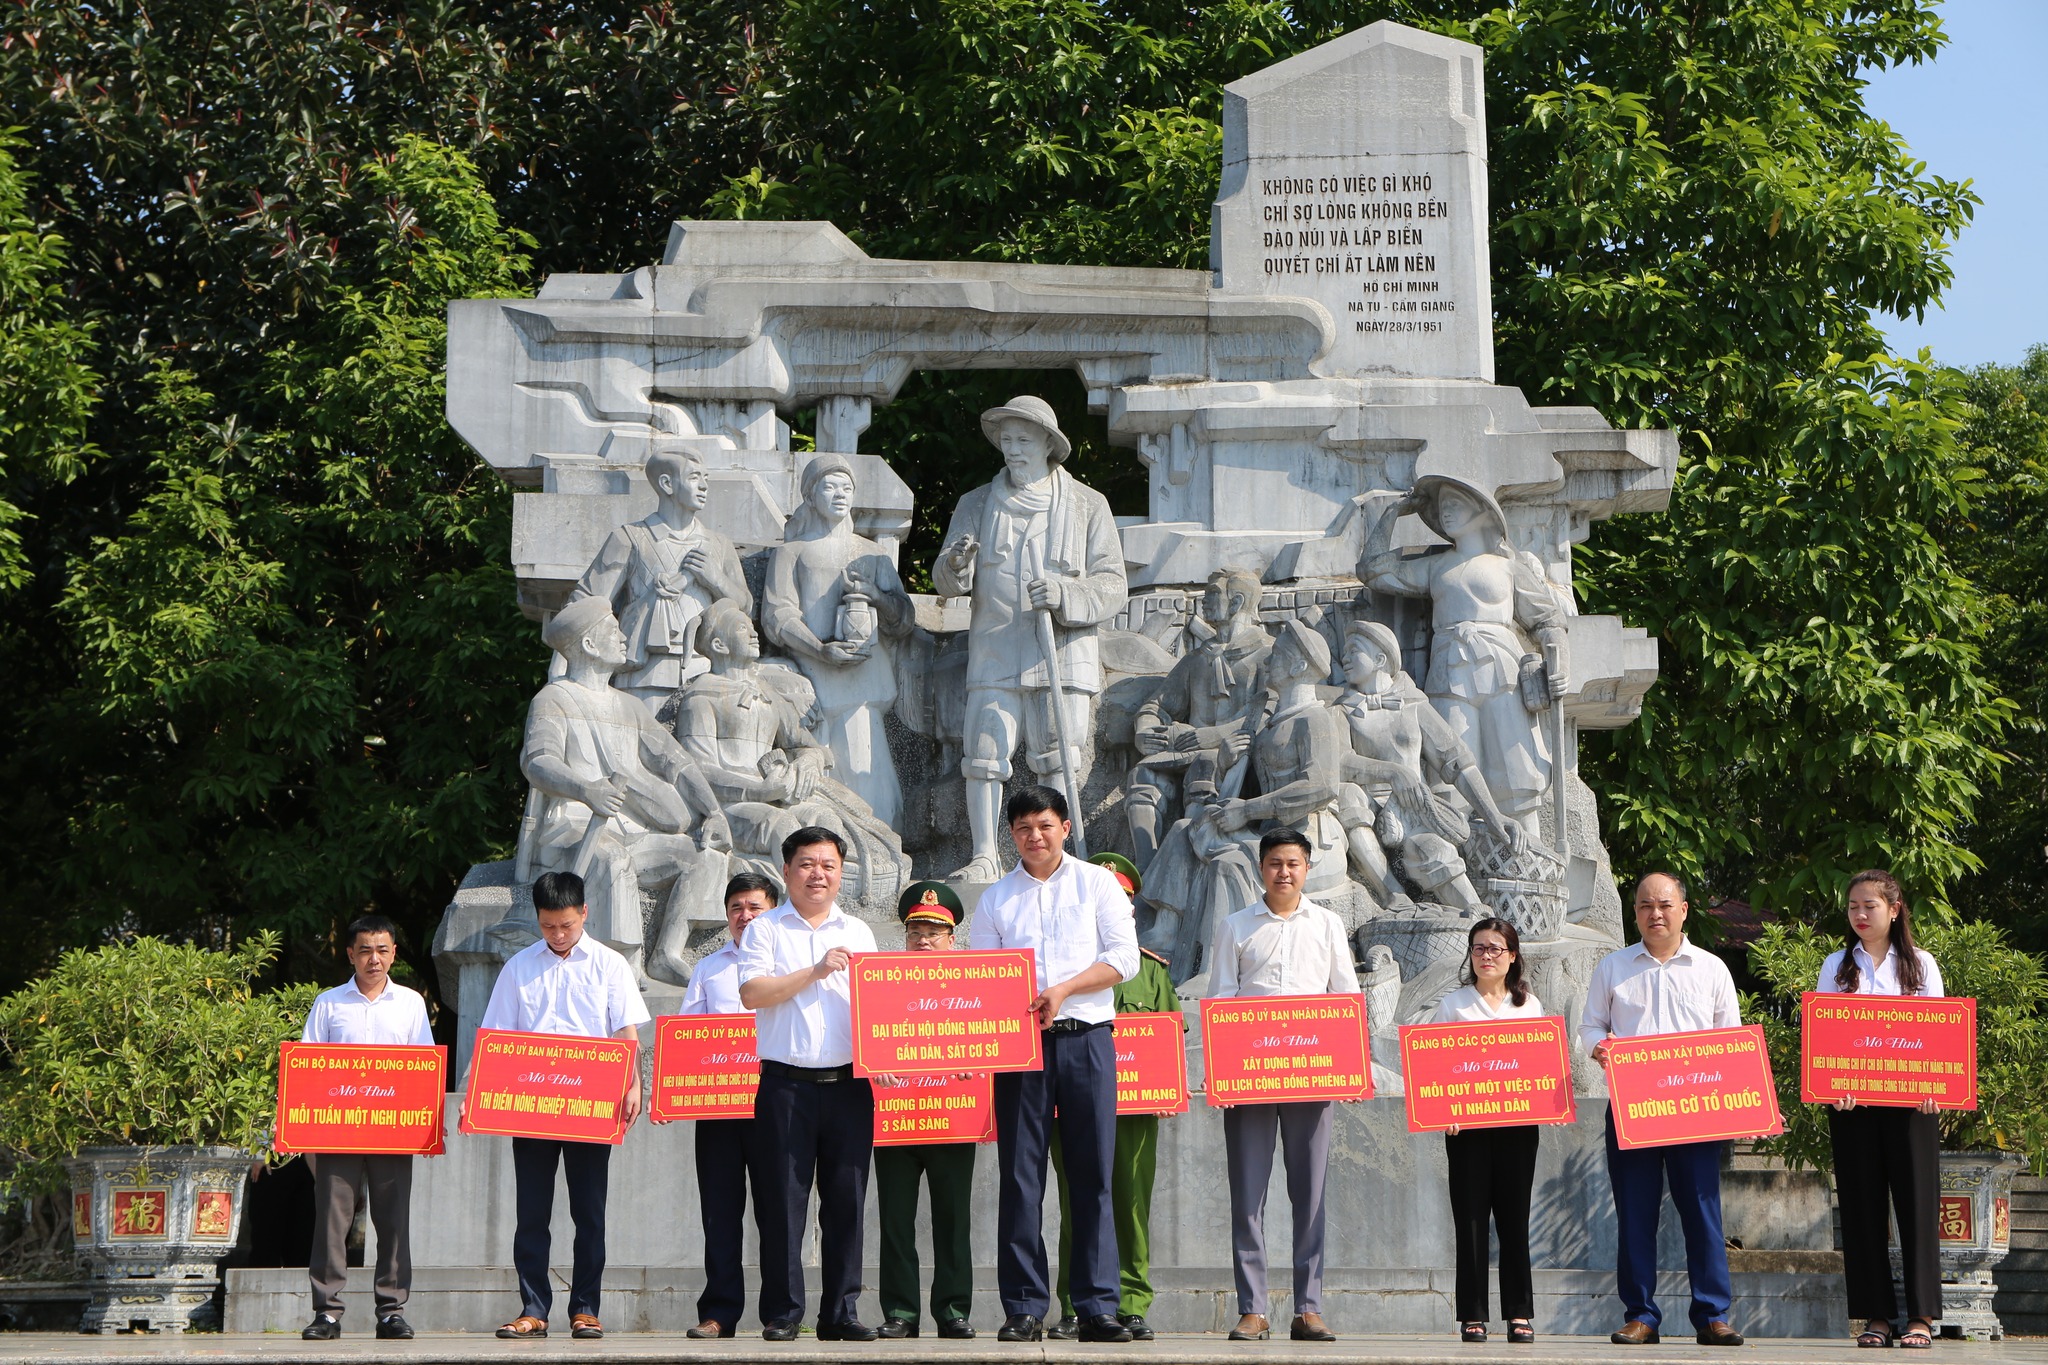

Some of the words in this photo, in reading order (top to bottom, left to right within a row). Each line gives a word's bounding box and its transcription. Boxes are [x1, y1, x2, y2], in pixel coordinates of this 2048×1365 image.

[1263, 176, 1313, 195] KHÔNG
[1344, 174, 1377, 196] VIỆC
[1383, 173, 1396, 192] GÌ
[1402, 172, 1432, 191] KHÓ
[1264, 200, 1288, 221] CHỈ
[1293, 203, 1313, 224] SỢ
[1318, 201, 1356, 219] LÒNG
[1362, 200, 1412, 219] KHÔNG
[1418, 196, 1447, 218] BỀN
[1263, 225, 1293, 247] ĐÀO
[1299, 223, 1324, 247] NÚI
[1330, 225, 1348, 246] VÀ
[1354, 224, 1381, 245] LẤP
[1388, 223, 1422, 245] BIỂN
[1264, 252, 1309, 275] QUYẾT
[1316, 254, 1340, 273] CHÍ
[1346, 252, 1362, 273] ẮT
[1368, 253, 1399, 272] LÀM
[1405, 253, 1435, 272] NÊN
[1384, 280, 1402, 292] CHÍ
[1408, 282, 1438, 291] MINH
[864, 970, 883, 981] CHI
[887, 966, 901, 984] BỘ
[906, 965, 925, 984] HỘI
[928, 962, 961, 980] ĐỒNG
[965, 964, 996, 979] NHÂN
[1000, 963, 1022, 978] DÂN
[907, 998, 938, 1011] Mô
[941, 996, 982, 1010] Hình
[1212, 1010, 1239, 1023] ĐẢNG
[1242, 1009, 1254, 1024] BỘ
[1257, 1008, 1268, 1021] UỶ
[1272, 1010, 1290, 1021] BAN
[1292, 1007, 1318, 1020] NHÂN
[1321, 1006, 1340, 1018] DÂN
[1342, 1006, 1355, 1018] XÃ
[1815, 1008, 1833, 1018] CHI
[1837, 1006, 1850, 1022] BỘ
[1853, 1008, 1874, 1020] VĂN
[1877, 1008, 1913, 1022] PHÒNG
[1916, 1009, 1946, 1023] ĐẢNG
[1949, 1010, 1962, 1024] UỶ
[675, 1030, 692, 1040] CHI
[696, 1026, 709, 1041] BỘ
[712, 1025, 724, 1038] UỶ
[728, 1028, 748, 1038] BAN
[872, 1024, 889, 1040] ĐẠI
[892, 1018, 914, 1037] BIỂU
[918, 1020, 934, 1039] HỘI
[938, 1017, 965, 1036] ĐỒNG
[968, 1019, 996, 1034] NHÂN
[1000, 1018, 1020, 1033] DÂN
[1122, 1028, 1136, 1037] AN
[1140, 1025, 1154, 1036] XÃ
[1253, 1036, 1280, 1048] Mô
[1283, 1035, 1319, 1046] Hình
[1412, 1036, 1439, 1050] ĐẢNG
[1442, 1035, 1454, 1050] BỘ
[1458, 1034, 1478, 1046] CÁC
[1481, 1035, 1495, 1044] CƠ
[1498, 1033, 1524, 1044] QUAN
[1527, 1029, 1554, 1042] ĐẢNG
[1853, 1036, 1882, 1048] Mô
[1885, 1037, 1923, 1049] Hình
[487, 1043, 500, 1053] CHI
[503, 1042, 514, 1057] BỘ
[517, 1042, 527, 1055] UỶ
[528, 1046, 545, 1056] BAN
[546, 1046, 562, 1061] MẶT
[565, 1048, 584, 1062] TRẬN
[587, 1046, 597, 1059] TỔ
[598, 1048, 622, 1062] QUỐC
[701, 1054, 727, 1064] Mô
[896, 1042, 917, 1061] GẦN
[921, 1044, 945, 1060] DÂN,
[947, 1042, 966, 1058] SÁT
[969, 1043, 982, 1058] CƠ
[985, 1039, 999, 1057] SỞ
[1614, 1053, 1631, 1064] CHI
[1635, 1049, 1648, 1065] BỘ
[1651, 1049, 1671, 1060] BAN
[1673, 1045, 1693, 1058] XÂY
[1696, 1044, 1724, 1059] DỰNG
[1727, 1039, 1755, 1053] ĐẢNG
[290, 1058, 308, 1068] CHI
[312, 1056, 326, 1072] BỘ
[329, 1059, 349, 1069] BAN
[352, 1057, 372, 1070] XÂY
[375, 1058, 404, 1073] DỰNG
[407, 1057, 436, 1071] ĐẢNG
[1243, 1056, 1260, 1070] XÂY
[1264, 1056, 1290, 1072] DỰNG
[1292, 1054, 1307, 1068] MÔ
[1310, 1053, 1332, 1067] HÌNH
[1453, 1061, 1480, 1073] Mô
[1483, 1059, 1519, 1070] Hình
[518, 1072, 545, 1083] Mô
[548, 1073, 582, 1086] Hình
[912, 1076, 948, 1088] Hình
[1216, 1080, 1229, 1091] DU
[1232, 1078, 1252, 1093] LỊCH
[1255, 1076, 1280, 1092] CỘNG
[1284, 1073, 1309, 1088] ĐỒNG
[1312, 1074, 1346, 1087] PHIÊNG
[1349, 1075, 1362, 1086] AN
[1420, 1082, 1443, 1098] MỖI
[1447, 1081, 1471, 1097] QUÝ
[1475, 1080, 1500, 1096] MỘT
[1504, 1078, 1532, 1094] VIỆC
[1535, 1074, 1556, 1089] TỐT
[1657, 1076, 1684, 1087] Mô
[1686, 1071, 1723, 1084] Hình
[1868, 1079, 1883, 1091] TRONG
[328, 1085, 356, 1096] Mô
[359, 1086, 396, 1096] Hình
[1142, 1088, 1176, 1102] MẠNG
[480, 1090, 492, 1109] THÍ
[493, 1087, 513, 1111] ĐIỂM
[514, 1092, 536, 1113] NÔNG
[537, 1094, 565, 1118] NGHIỆP
[566, 1096, 592, 1117] THÔNG
[593, 1101, 614, 1119] MINH
[880, 1098, 915, 1113] LƯỢNG
[919, 1096, 942, 1110] DÂN
[946, 1094, 976, 1110] QUÂN
[1451, 1102, 1462, 1116] VÌ
[1467, 1100, 1501, 1115] NHÂN
[1504, 1098, 1530, 1112] DÂN
[1628, 1098, 1677, 1119] ĐƯỜNG
[1680, 1094, 1699, 1113] CỜ
[1702, 1089, 1720, 1111] TỔ
[1724, 1086, 1762, 1110] QUỐC
[289, 1103, 310, 1124] MỖI
[313, 1104, 341, 1124] TUẦN
[344, 1106, 368, 1128] MỘT
[371, 1110, 396, 1128] NGHỊ
[400, 1106, 433, 1128] QUYẾT
[882, 1120, 889, 1132] 3
[893, 1115, 915, 1131] SẴN
[919, 1116, 949, 1130] SÀNG
